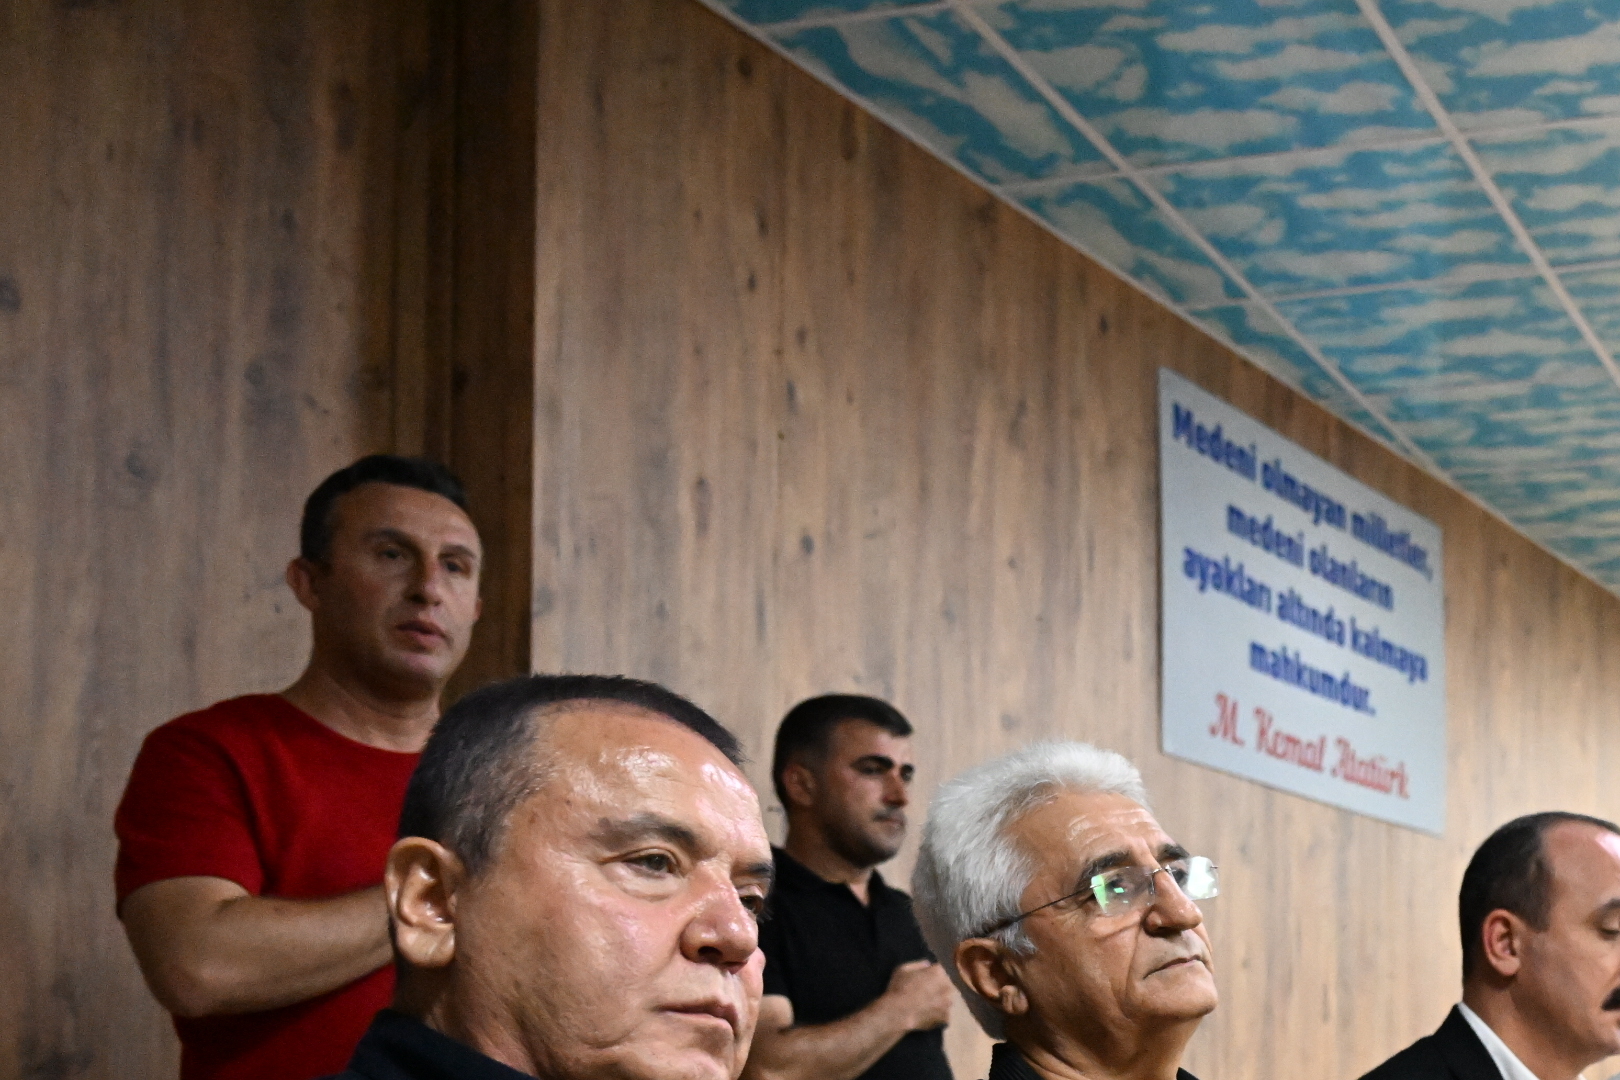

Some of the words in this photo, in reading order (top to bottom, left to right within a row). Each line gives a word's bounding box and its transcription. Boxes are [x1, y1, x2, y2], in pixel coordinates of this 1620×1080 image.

[1172, 402, 1257, 482] Medeni
[1261, 457, 1348, 531] olmayan
[1226, 503, 1305, 568] medeni
[1182, 546, 1273, 613] ayakları
[1350, 615, 1429, 684] kalmaya
[1209, 691, 1245, 747] M.
[1253, 706, 1327, 773] Kemal
[1330, 735, 1410, 799] Atatürk
